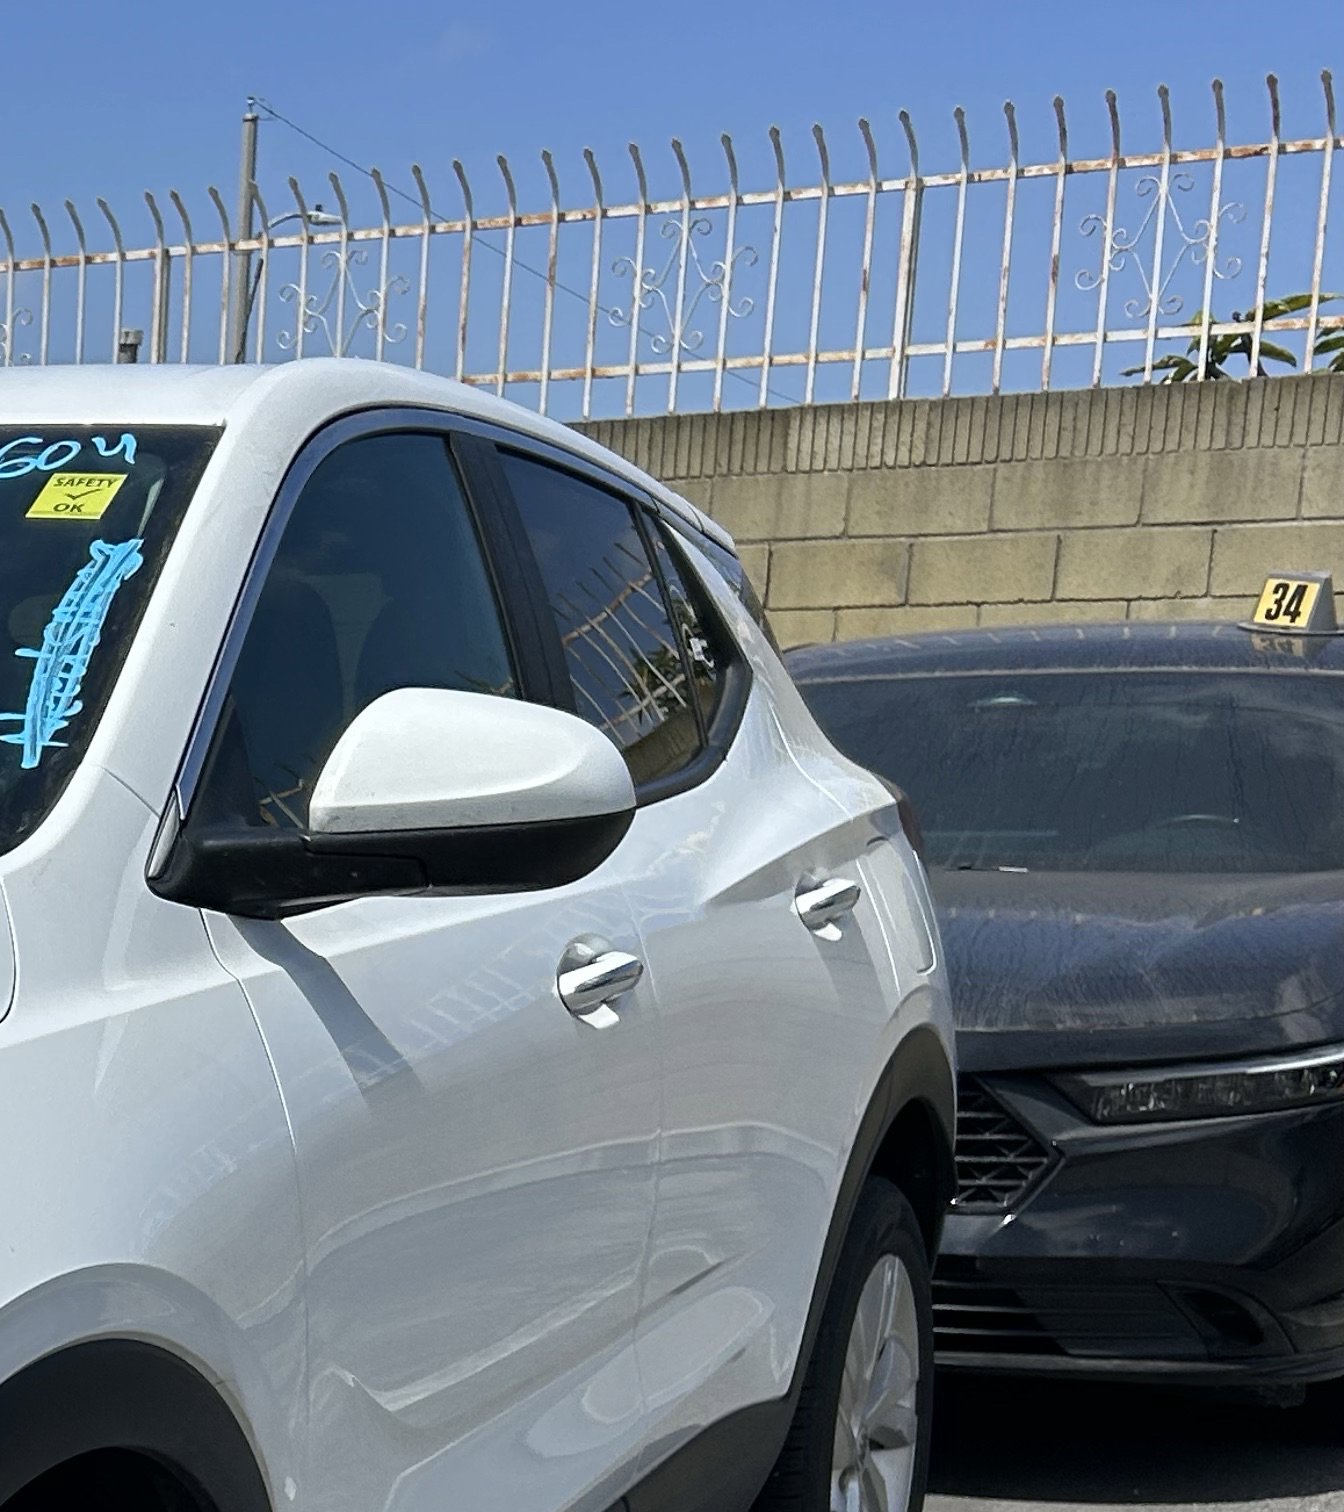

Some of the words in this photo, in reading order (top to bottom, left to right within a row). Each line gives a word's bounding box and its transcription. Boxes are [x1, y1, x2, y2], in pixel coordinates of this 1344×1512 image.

[53, 477, 119, 488] SAFETY
[53, 503, 85, 513] OK
[1265, 583, 1308, 623] 34
